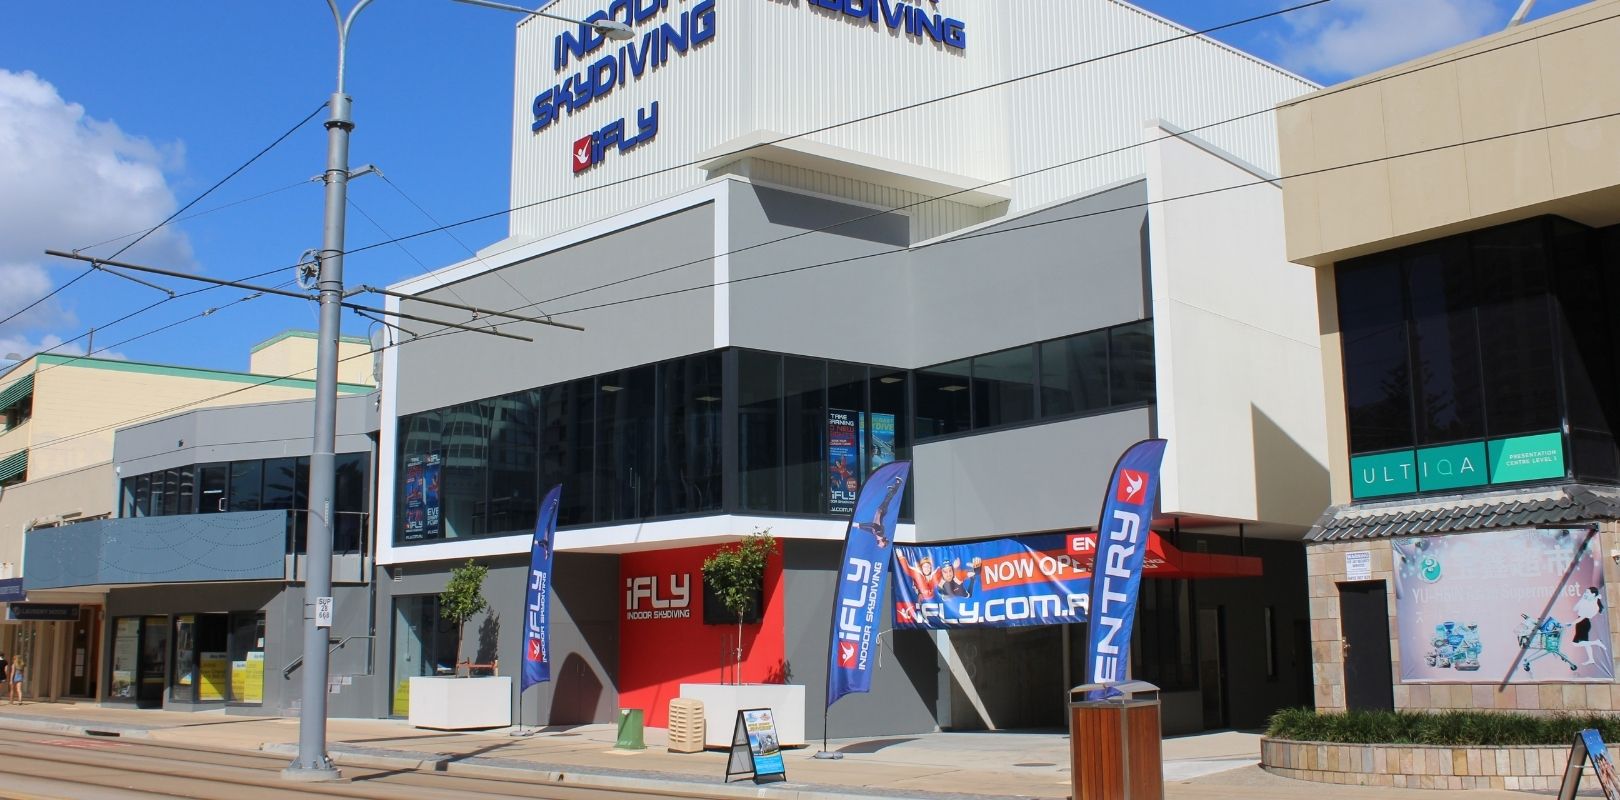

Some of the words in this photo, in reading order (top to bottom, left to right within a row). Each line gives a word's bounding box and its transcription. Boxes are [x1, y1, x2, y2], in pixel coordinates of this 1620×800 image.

[554, 0, 668, 71] INDOO
[532, 0, 716, 131] SKYDIVING
[1363, 457, 1475, 484] ULTIQA
[1509, 449, 1556, 459] PRESENTATION
[1532, 456, 1552, 464] LEVEL
[984, 558, 1033, 584] NOW
[529, 569, 542, 638] iFLY
[627, 573, 690, 610] iFLY
[839, 557, 871, 641] iFLY
[916, 593, 1088, 624] iFLY.COM.A
[1094, 509, 1140, 684] ENTRY
[627, 611, 652, 620] INDOOR
[653, 609, 690, 619] SKYDIVING
[858, 626, 872, 670] INDOOR
[866, 561, 882, 622] SKYDIVING
